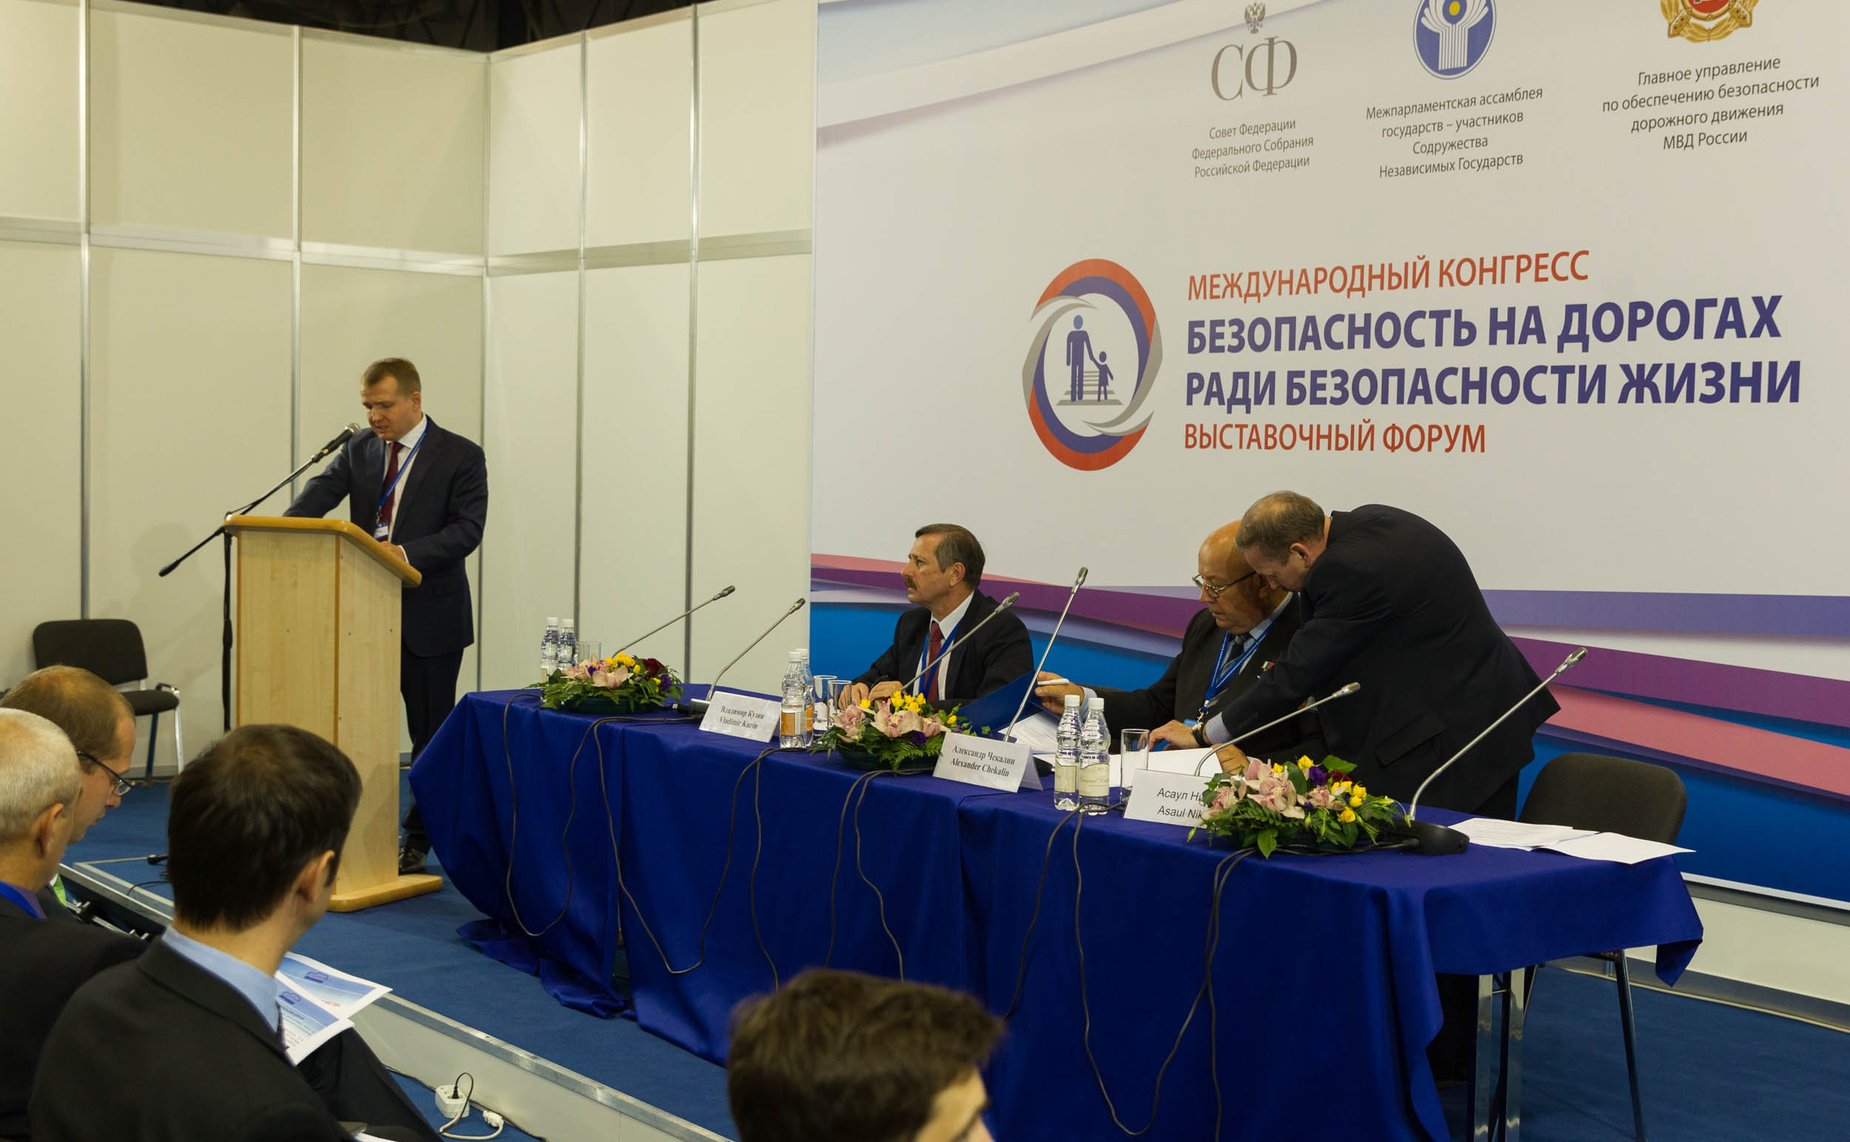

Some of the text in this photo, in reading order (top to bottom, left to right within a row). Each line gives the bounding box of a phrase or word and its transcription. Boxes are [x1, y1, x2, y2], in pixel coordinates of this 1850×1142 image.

[1211, 36, 1298, 101] СФ
[1638, 57, 1781, 86] Главное управление
[1366, 87, 1543, 120] Межпарламентская ассамблея
[1602, 76, 1820, 112] по обеспечению безопасности
[1209, 119, 1296, 139] Совет Федерации
[1382, 121, 1444, 139] государств
[1455, 111, 1524, 132] участников
[1631, 104, 1784, 133] дорожного движения
[1192, 137, 1314, 160] Федерального Собрания
[1413, 137, 1488, 155] Содружества
[1663, 130, 1748, 150] МВД России
[1194, 157, 1310, 178] Российской Федерации
[1379, 153, 1524, 179] Независимых Государств
[1188, 250, 1589, 304] МЕЖДУНАРОДНЫЙ КОНГРЕСС
[1187, 295, 1783, 354] БЕЗОПАСНОСТЬ НА ДОРОГАХ
[1185, 360, 1801, 414] РАДИ БЕЗОПАСНОСТИ ЖИЗНИ
[1184, 418, 1485, 453] ВЫСТАВОЧНЫЙ ФОРУМ
[951, 758, 1010, 777] Alexander Chekalin
[953, 745, 1015, 765] Александр Чекалин
[1157, 787, 1188, 802] Асаул
[1157, 805, 1186, 818] Asaul
